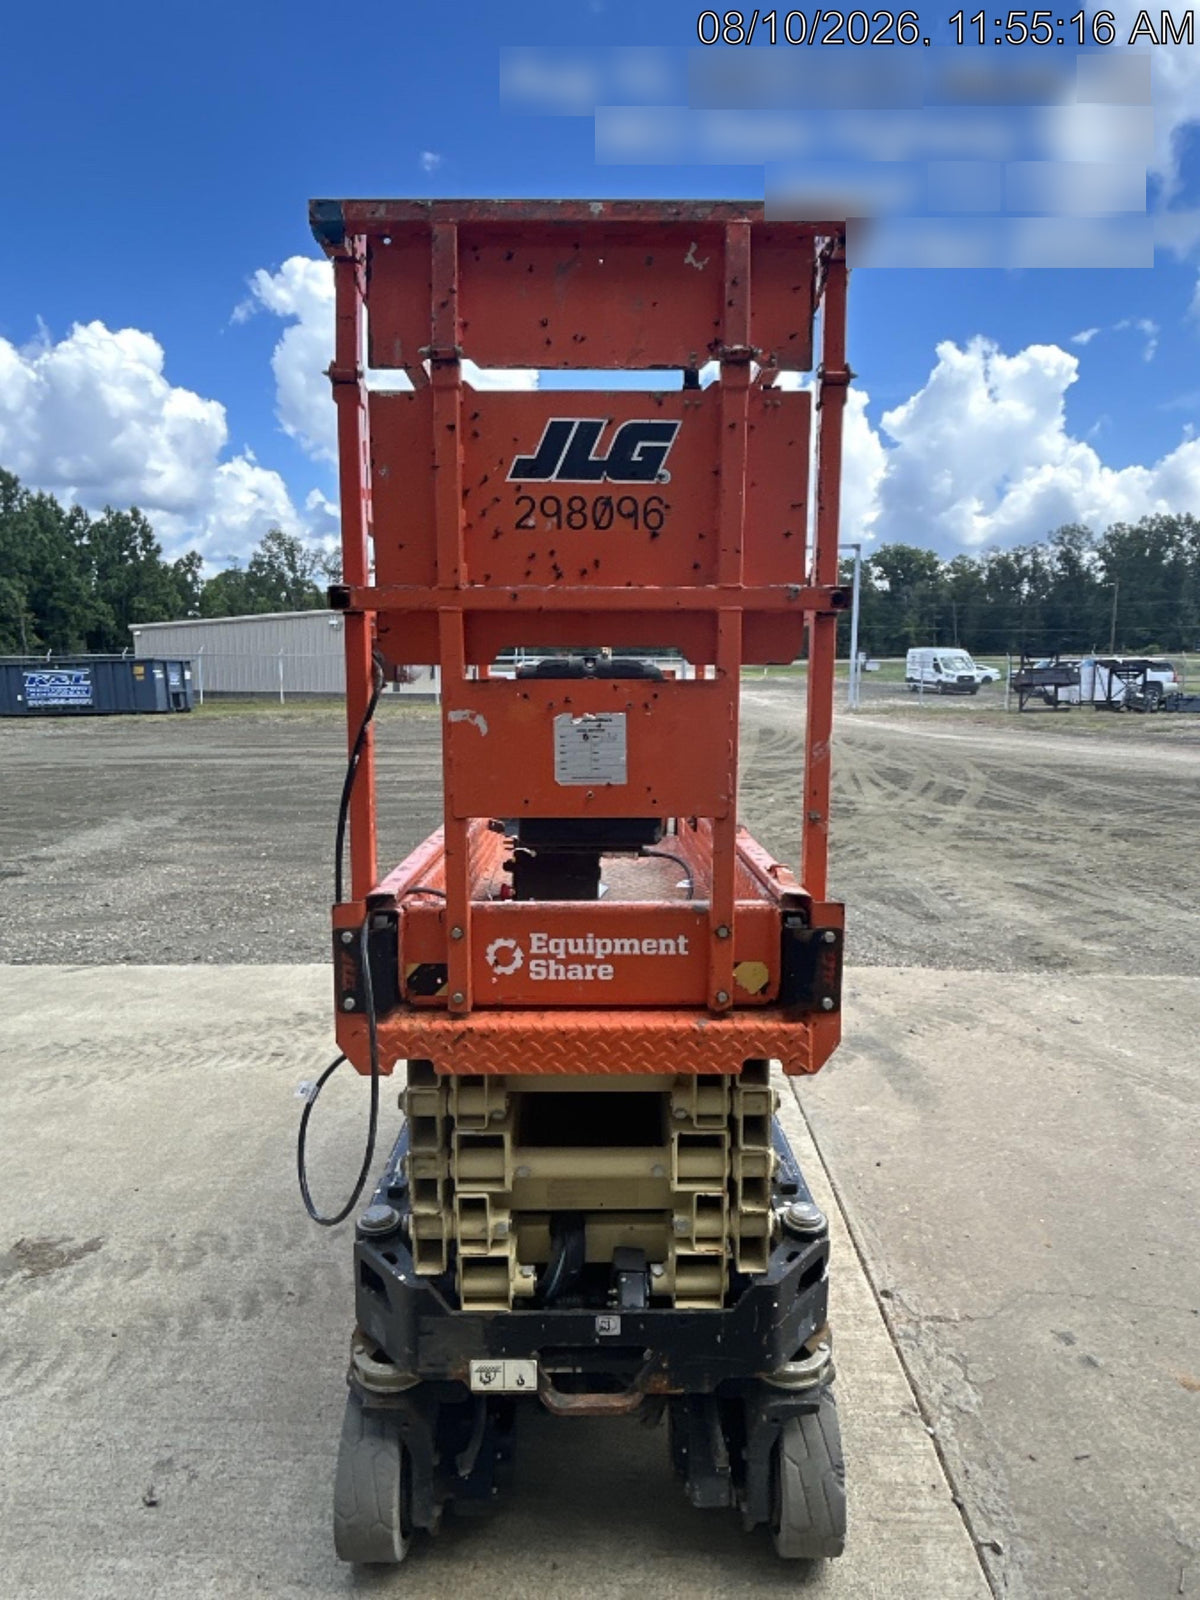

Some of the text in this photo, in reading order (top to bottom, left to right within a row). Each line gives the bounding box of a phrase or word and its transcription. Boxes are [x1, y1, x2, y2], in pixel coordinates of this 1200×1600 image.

[505, 417, 682, 484] JLG
[515, 495, 664, 531] 298096
[529, 933, 689, 959] Equipment
[529, 959, 614, 980] Share
